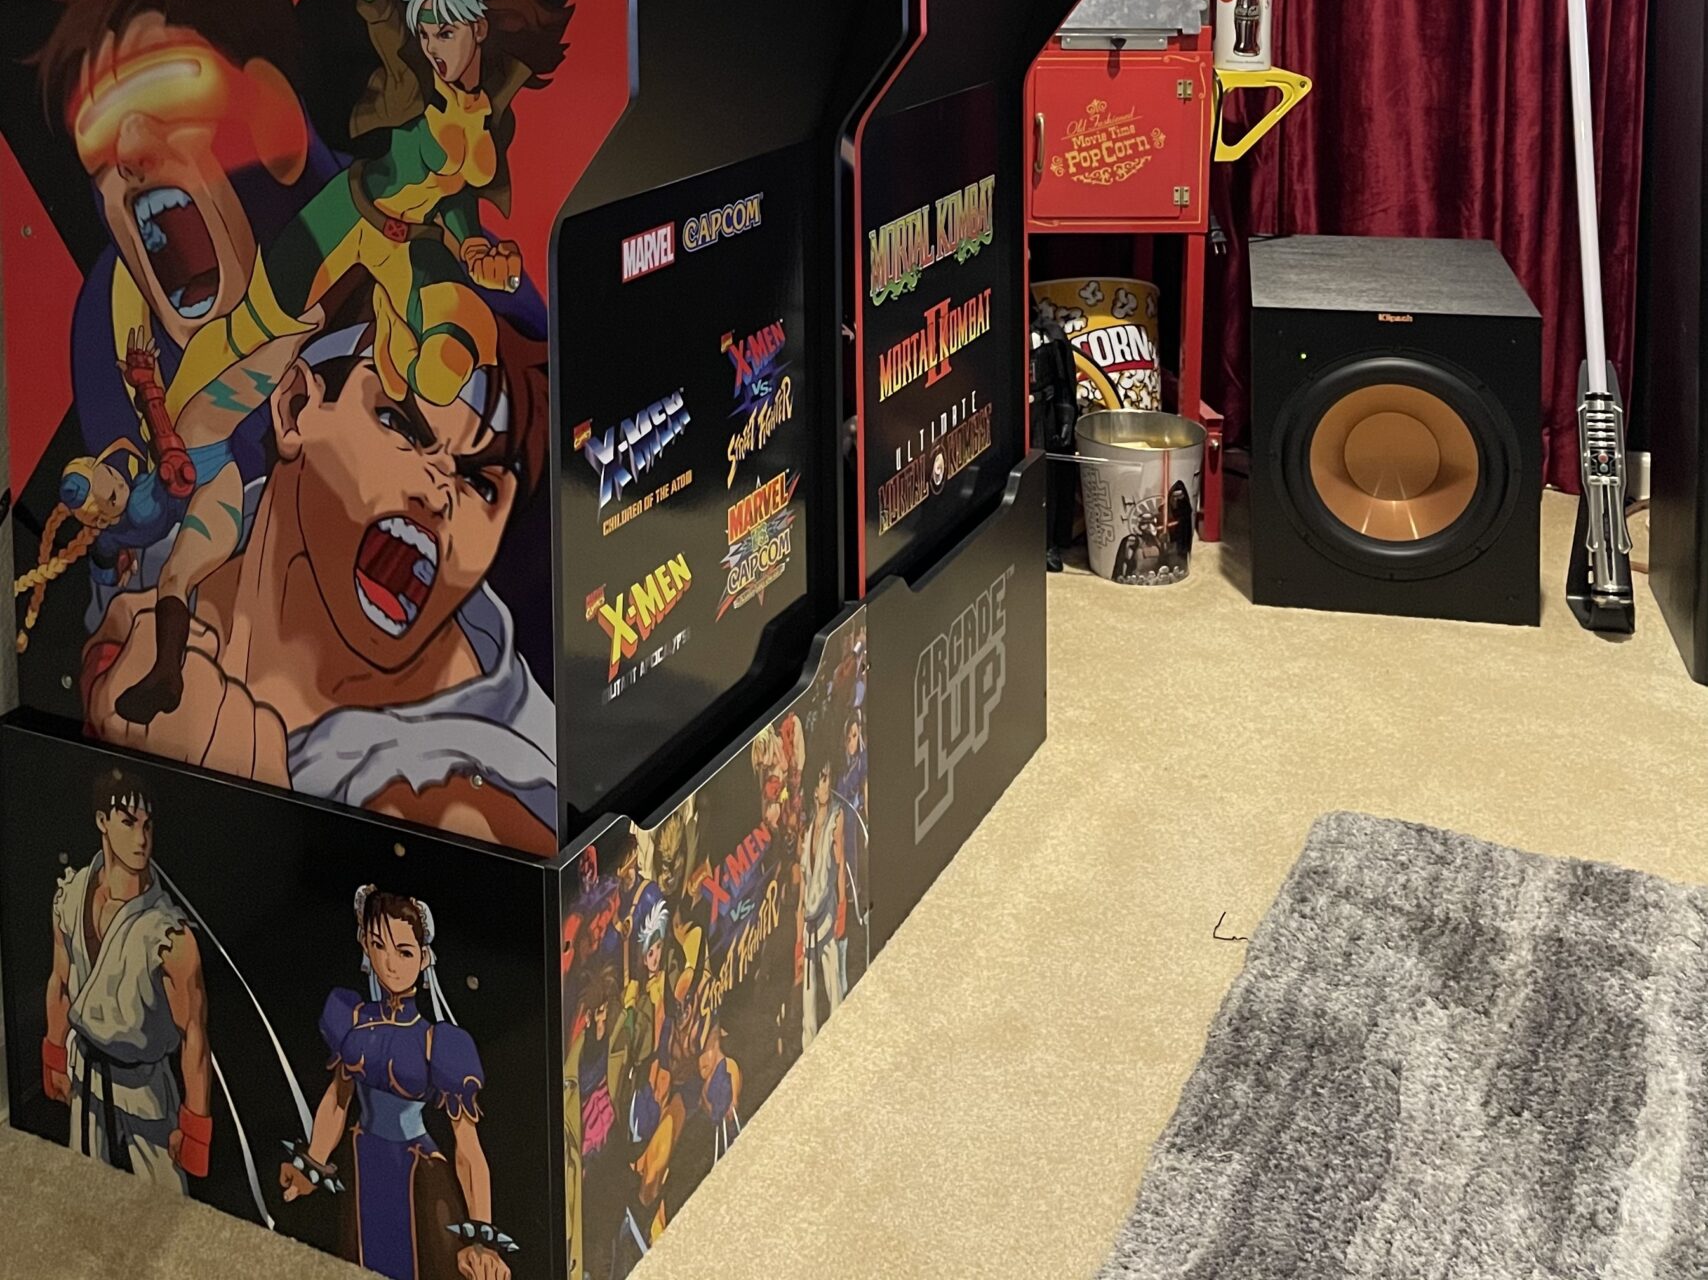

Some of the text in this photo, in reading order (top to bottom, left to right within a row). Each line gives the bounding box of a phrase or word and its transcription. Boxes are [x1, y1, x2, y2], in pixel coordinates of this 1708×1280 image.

[1108, 125, 1135, 138] Time
[623, 194, 762, 280] MARVEL CAPCOM
[869, 174, 995, 297] MORTAL KOMBAT
[729, 321, 786, 394] X-MEN
[879, 288, 991, 400] MORTAL KOMBAT
[727, 375, 793, 490] STREET FIGHTER
[603, 469, 692, 536] CHILDREN OF THE ATOM
[728, 471, 789, 545] MARVEL
[598, 552, 692, 675] X-MEN
[727, 528, 791, 595] CAPCOM
[914, 572, 1006, 720] ARCADE
[703, 821, 771, 927] X-MEN
[700, 880, 780, 1050] STREET FIGHTER
